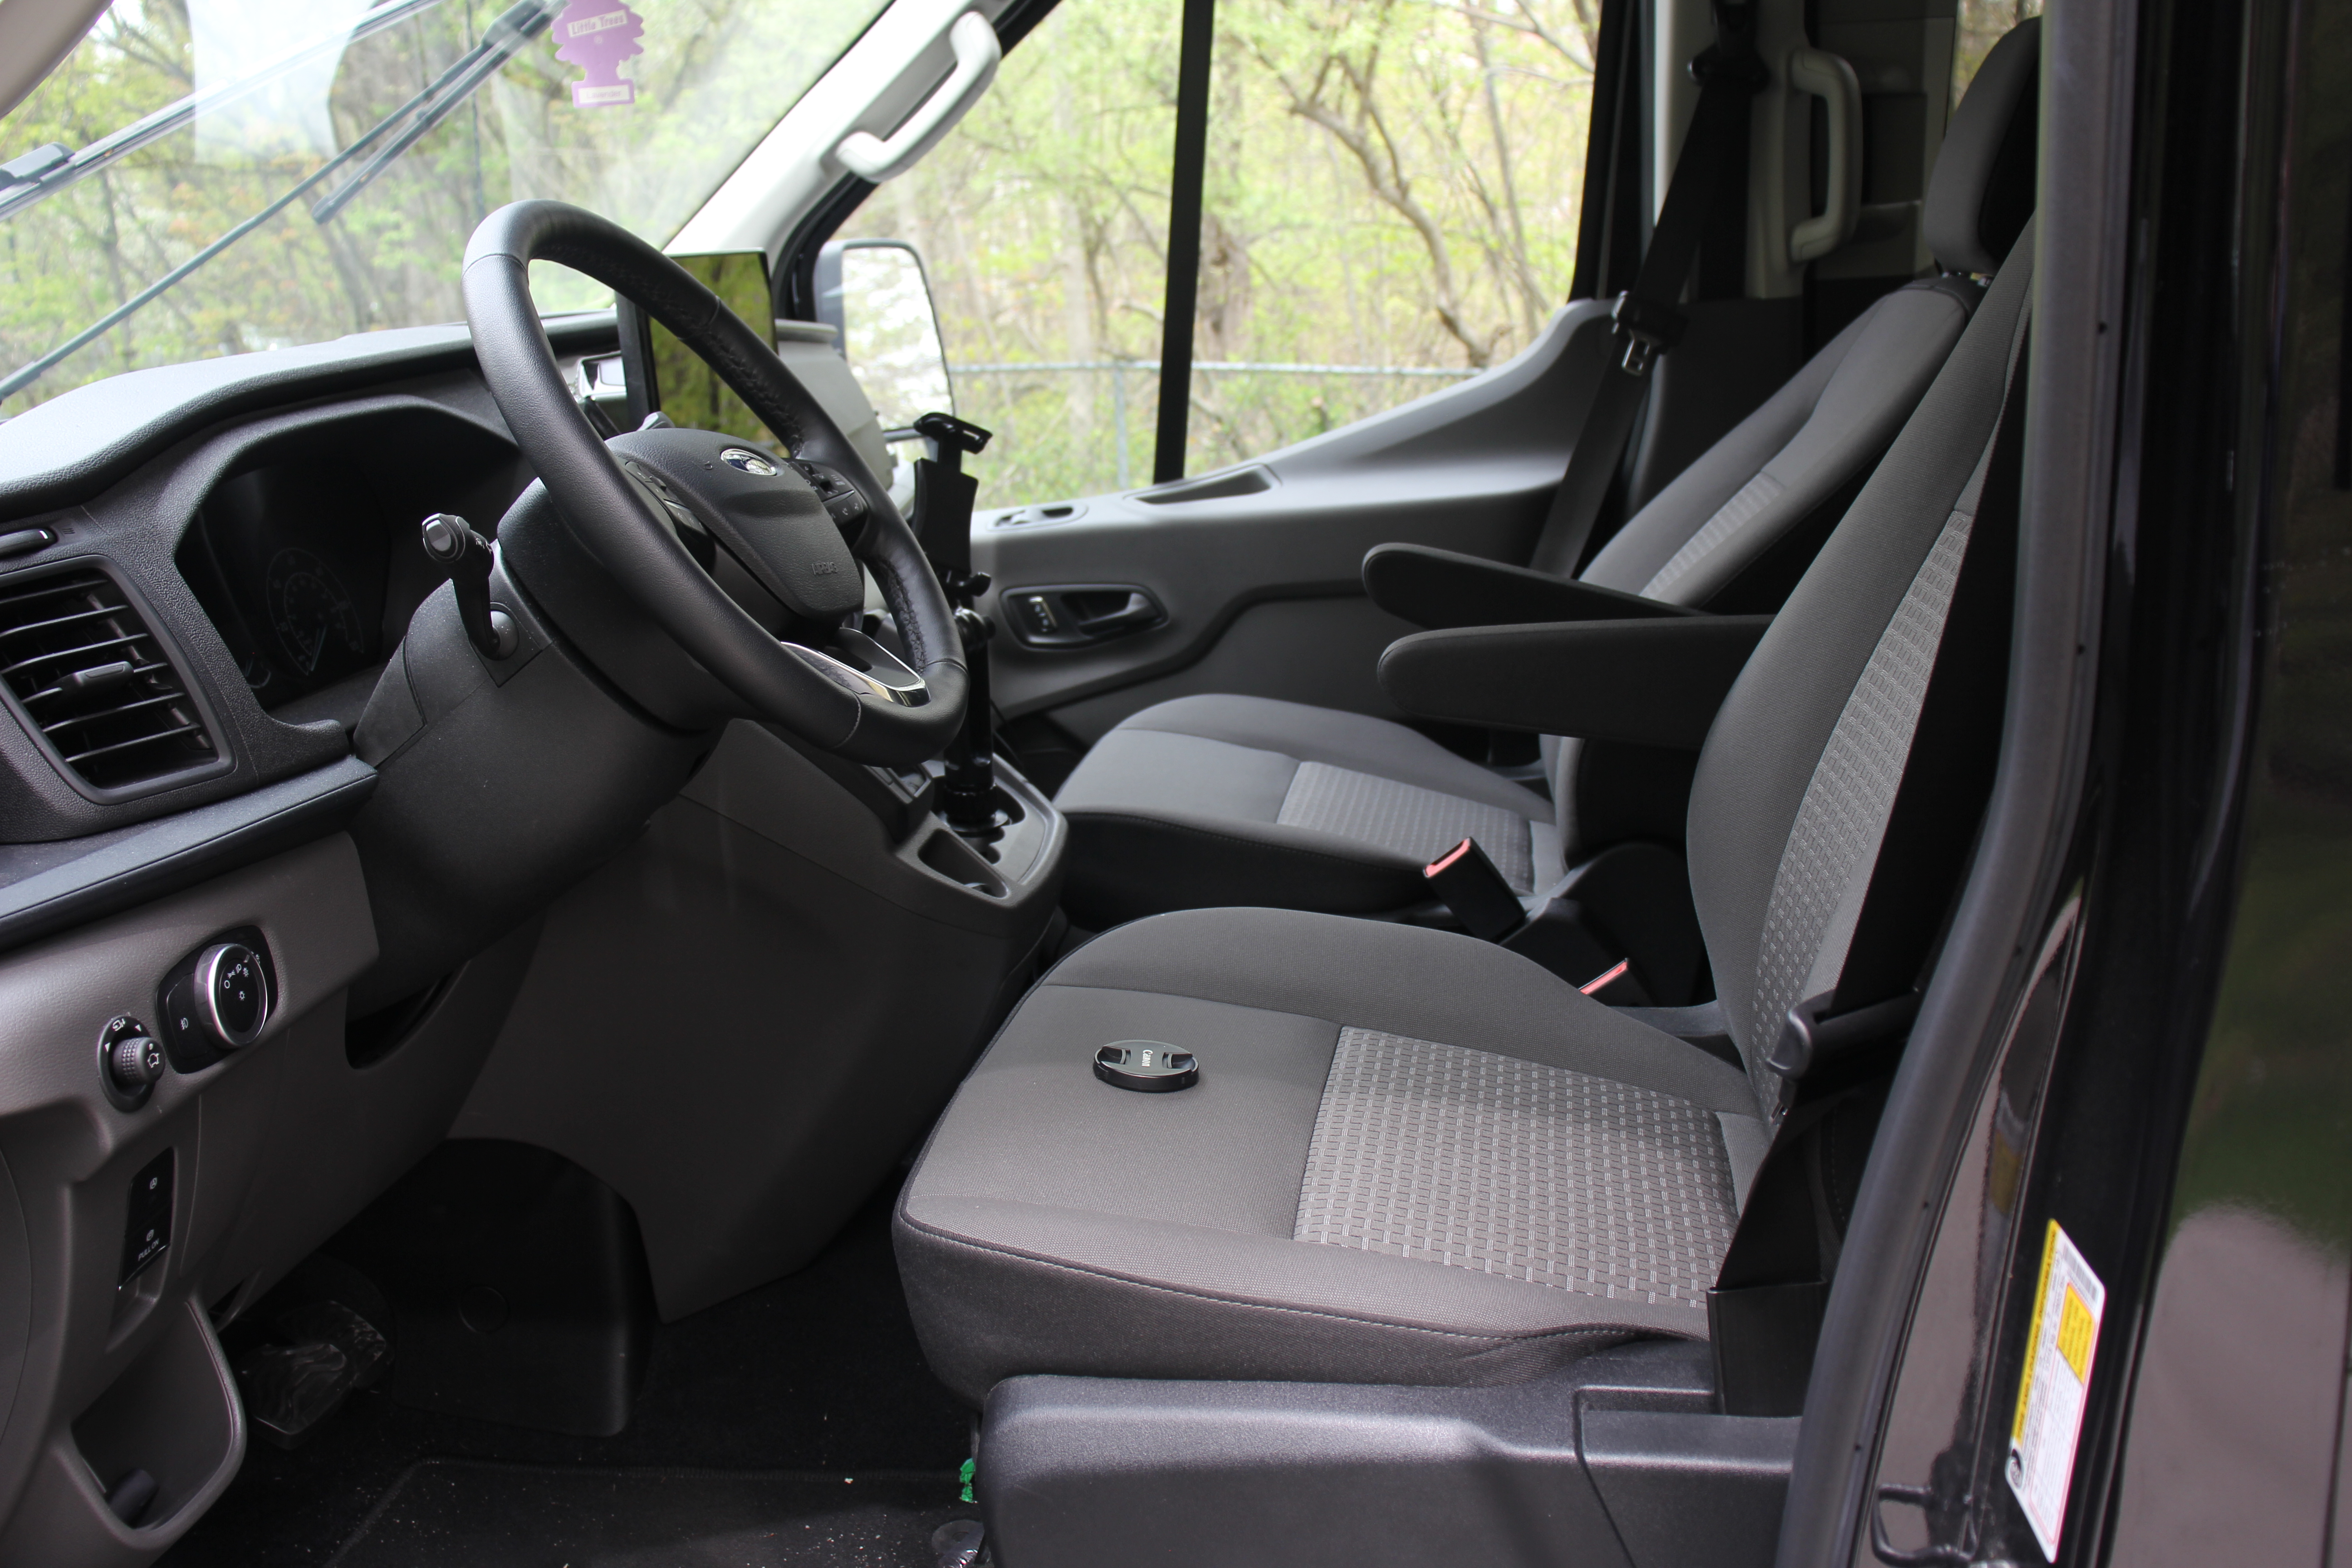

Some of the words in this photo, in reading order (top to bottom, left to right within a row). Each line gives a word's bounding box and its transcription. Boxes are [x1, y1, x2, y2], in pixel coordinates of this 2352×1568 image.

[571, 19, 596, 35] Little
[599, 13, 624, 29] Trees
[811, 562, 838, 575] AIRBAG
[1142, 1049, 1153, 1067] Canon
[138, 1246, 151, 1261] PULL
[151, 1238, 159, 1250] ON
